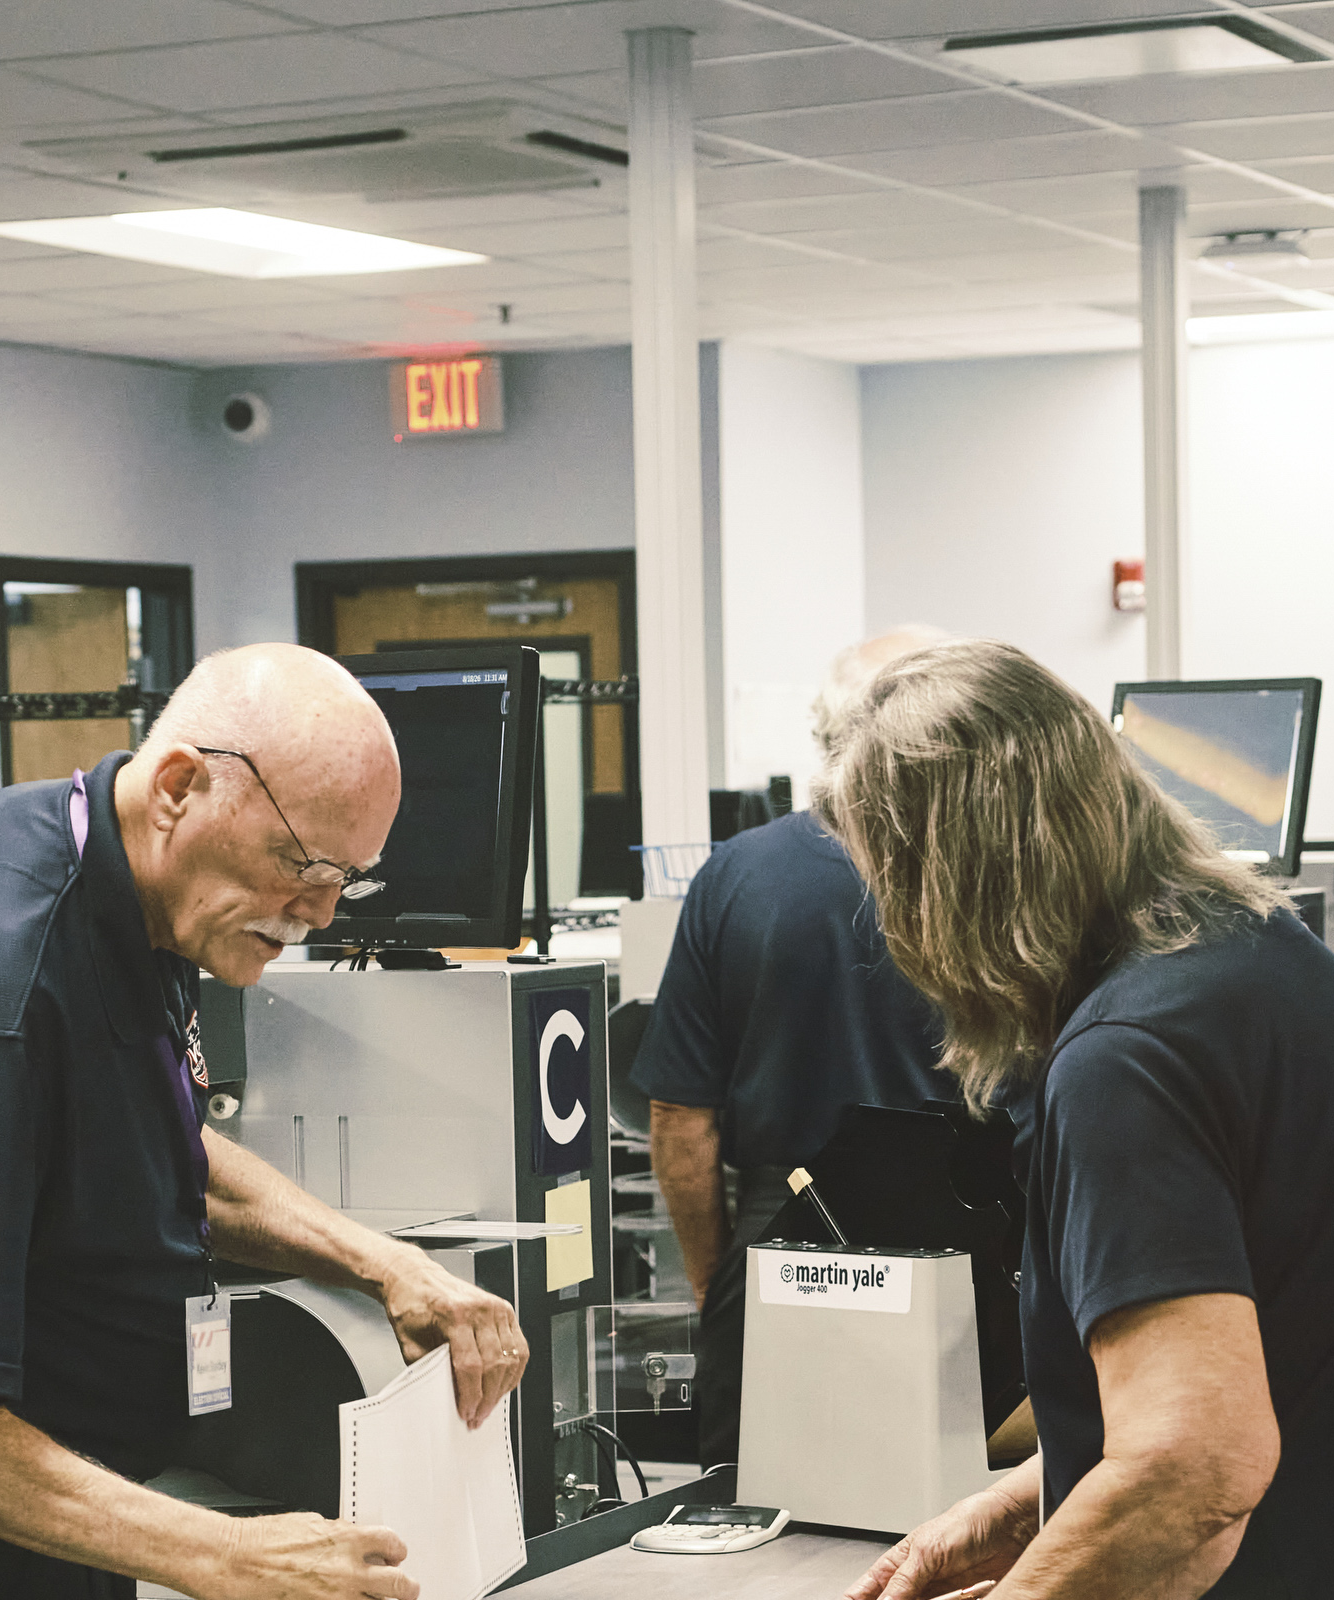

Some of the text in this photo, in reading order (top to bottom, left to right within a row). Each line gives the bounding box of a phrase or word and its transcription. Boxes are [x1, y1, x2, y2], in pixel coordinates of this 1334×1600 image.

[405, 359, 483, 432] EXIT
[538, 1009, 587, 1145] C
[795, 1262, 849, 1286] martin
[796, 1283, 828, 1295] Jogger 400
